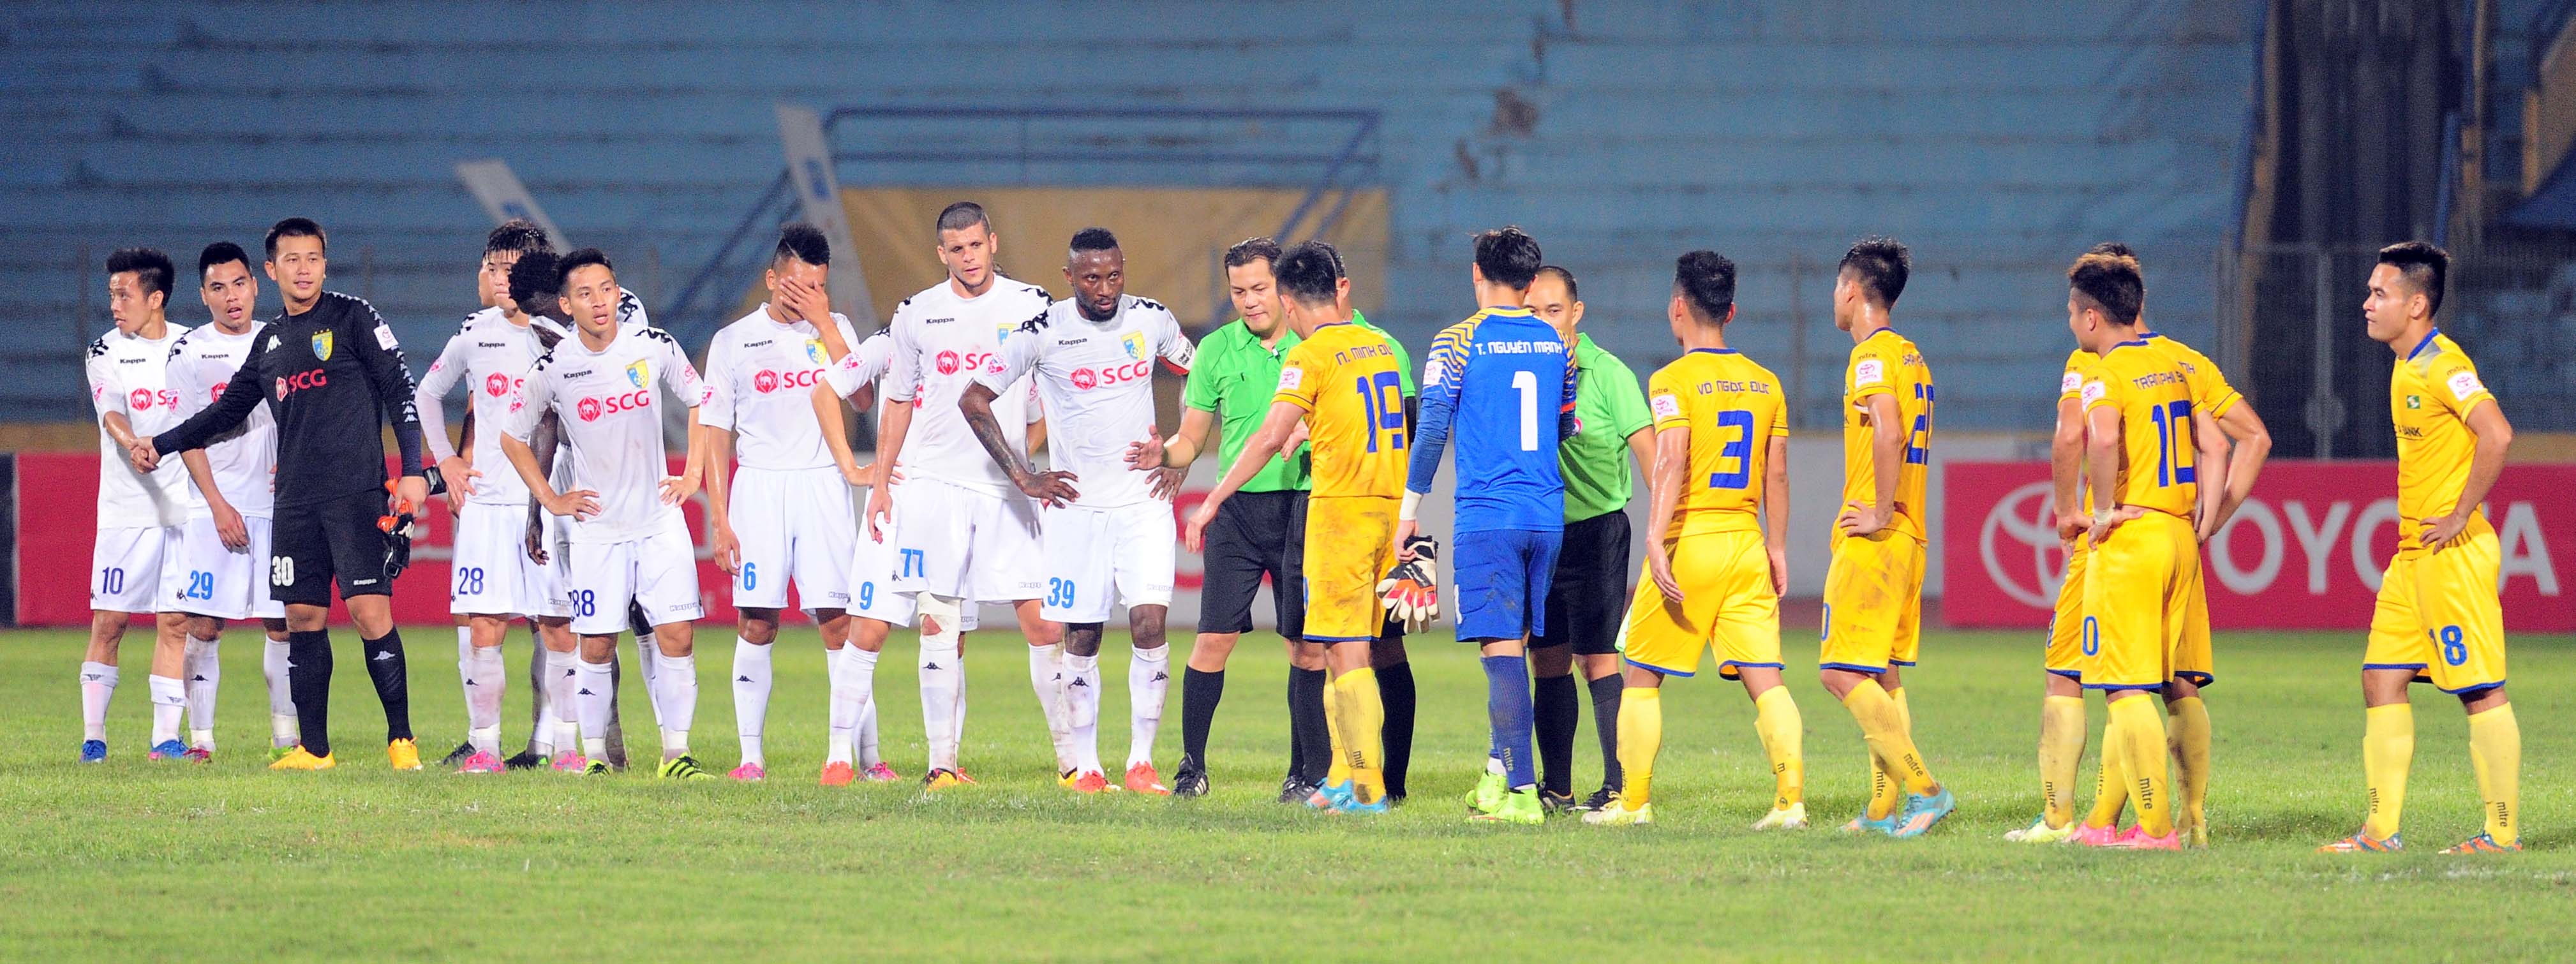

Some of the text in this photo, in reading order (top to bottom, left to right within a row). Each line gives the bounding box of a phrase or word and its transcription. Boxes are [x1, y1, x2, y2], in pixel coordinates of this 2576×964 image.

[744, 339, 773, 348] Kappa
[1059, 337, 1088, 346] Kappa
[1475, 343, 1486, 355] T.
[1103, 360, 1148, 384] SCG
[1335, 352, 1351, 366] N.
[289, 368, 327, 392] SCG
[563, 369, 593, 380] Kappa
[606, 390, 650, 413] SCG
[1357, 371, 1404, 453] 19
[1512, 371, 1538, 452] 1
[1709, 410, 1754, 489] 3
[2151, 399, 2196, 487] 10
[2210, 497, 2560, 595] OYOA
[271, 556, 294, 586] 30
[743, 562, 756, 591] 6
[900, 548, 924, 577] 77
[102, 567, 124, 595] 10
[186, 570, 214, 600] 29
[459, 567, 484, 595] 28
[1047, 577, 1075, 609] 39
[572, 589, 595, 618] 88
[860, 581, 874, 610] 9
[2429, 625, 2468, 666] 18
[1353, 750, 1365, 769] mitr
[1503, 747, 1514, 771] mitre
[1903, 753, 1923, 776] mitre
[1876, 771, 1886, 798] mitre
[2045, 781, 2057, 808] mitre
[2139, 777, 2154, 810] mitre
[2369, 787, 2379, 814] mitre
[2496, 801, 2508, 828] mitre
